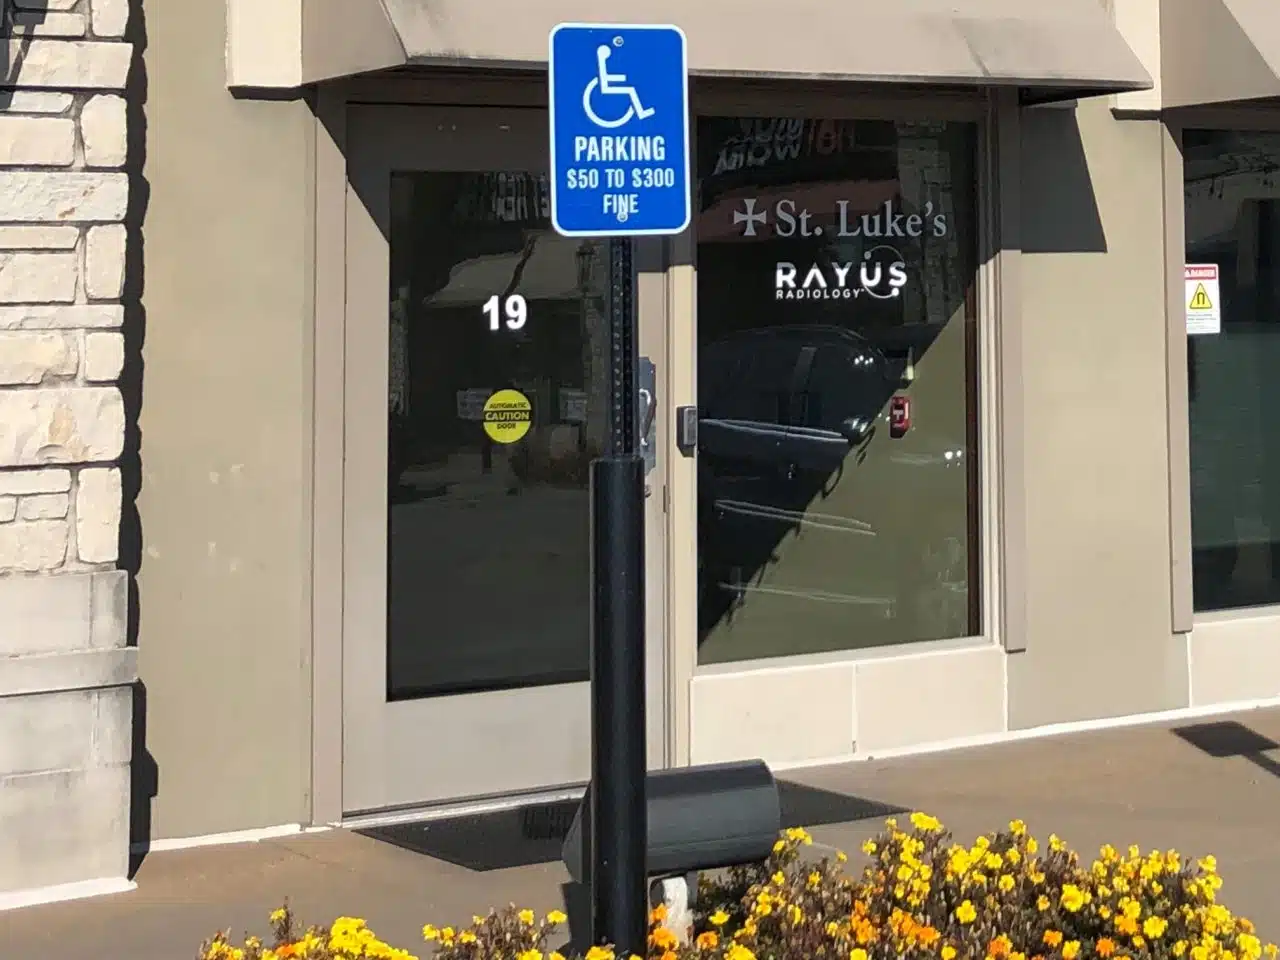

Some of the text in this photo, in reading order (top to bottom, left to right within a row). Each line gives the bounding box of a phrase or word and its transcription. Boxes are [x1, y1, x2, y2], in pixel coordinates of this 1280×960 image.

[574, 135, 666, 162] PARKING
[566, 167, 675, 190] $50 TO $300
[602, 193, 640, 215] FINE
[775, 199, 948, 237] St. Luke's
[775, 261, 908, 289] RAYUS
[775, 289, 862, 300] RADIOLOGY
[482, 293, 528, 331] 19
[484, 410, 530, 422] CAUTION
[496, 422, 517, 430] DOOR
